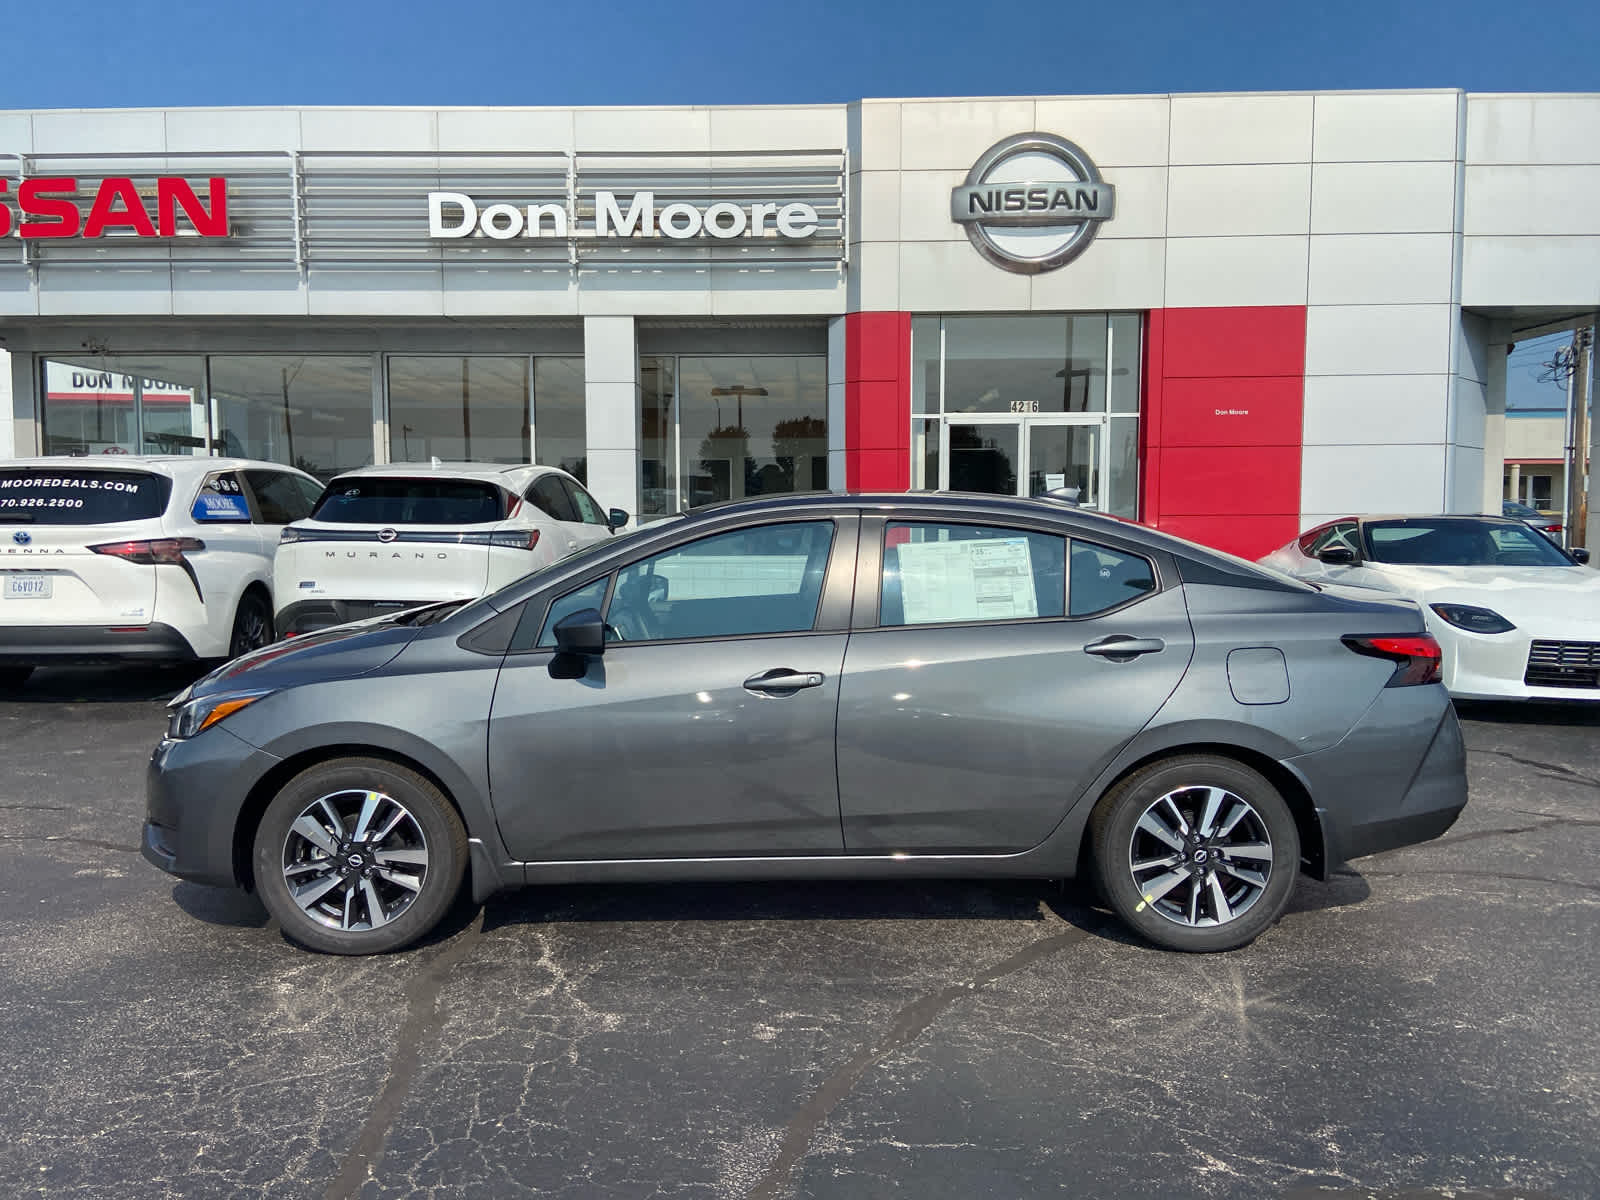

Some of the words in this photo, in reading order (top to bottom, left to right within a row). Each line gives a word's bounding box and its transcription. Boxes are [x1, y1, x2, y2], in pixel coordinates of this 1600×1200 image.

[968, 188, 1099, 214] NISSAN
[427, 192, 568, 239] Don
[595, 191, 819, 239] Moore
[1, 479, 138, 493] MOOREDEALS.COM
[0, 499, 84, 508] 70.926.2500
[326, 551, 447, 559] MURANO
